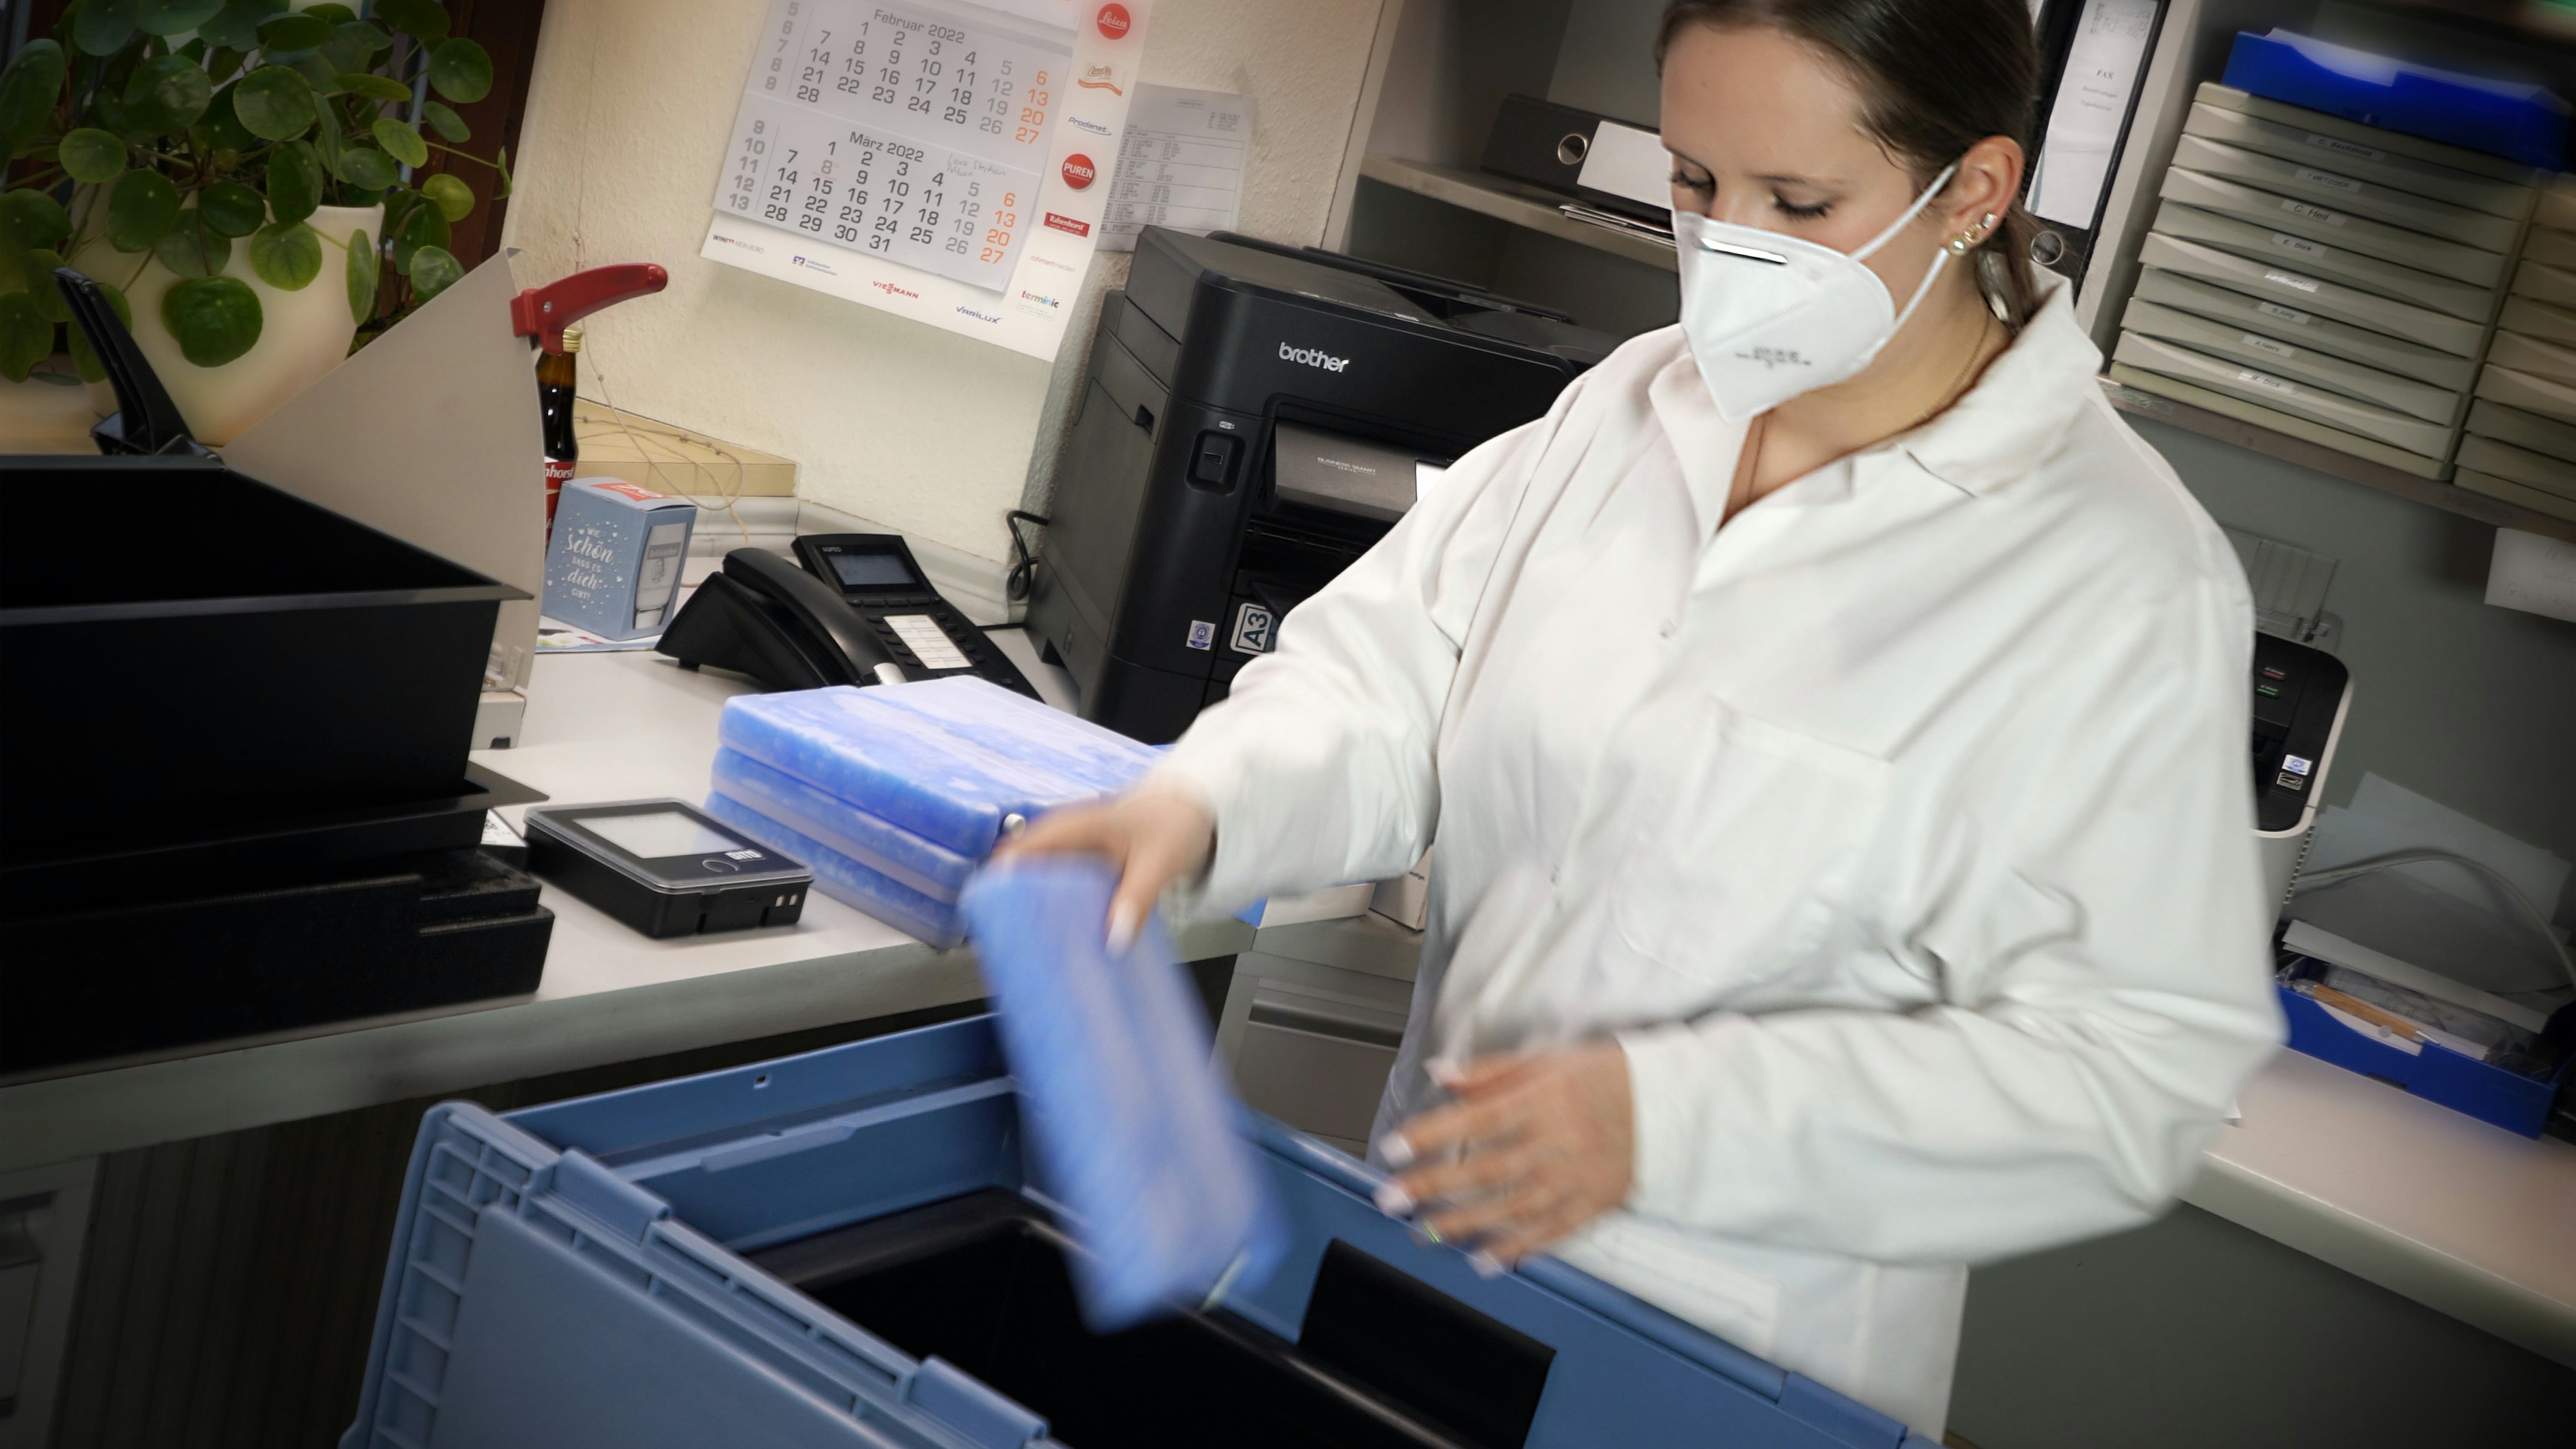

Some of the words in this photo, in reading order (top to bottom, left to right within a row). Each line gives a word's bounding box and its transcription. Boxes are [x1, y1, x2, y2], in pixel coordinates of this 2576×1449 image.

[874, 9, 924, 33] Februar
[928, 24, 965, 44] 2022
[1098, 12, 1127, 29] Leica
[787, 2, 799, 16] 5
[860, 22, 869, 35] 1
[893, 30, 906, 46] 2
[929, 40, 941, 56] 3
[964, 51, 976, 66] 4
[1001, 60, 1013, 75] 5
[1036, 70, 1048, 85] 6
[782, 21, 793, 35] 6
[820, 30, 831, 44] 7
[854, 40, 866, 55] 8
[888, 49, 900, 65] 9
[921, 58, 942, 76] 10
[956, 68, 975, 86] 11
[991, 79, 1013, 96] 12
[1029, 88, 1049, 107] 13
[2096, 70, 2114, 79] FAX
[765, 76, 777, 91] 9
[796, 85, 820, 103] 28
[777, 39, 788, 53] 7
[811, 48, 830, 66] 14
[845, 58, 865, 75] 15
[880, 67, 900, 85] 16
[915, 77, 937, 94] 17
[951, 88, 972, 106] 18
[986, 97, 1008, 115] 19
[1020, 107, 1045, 126] 20
[771, 58, 782, 72] 8
[802, 66, 824, 84] 21
[837, 76, 860, 95] 22
[872, 86, 896, 104] 23
[907, 96, 931, 115] 24
[943, 106, 968, 125] 25
[979, 117, 1003, 134] 26
[1015, 126, 1039, 144] 27
[1068, 117, 1107, 132] Prodanet
[849, 131, 884, 152] März
[886, 142, 924, 163] 2022
[753, 120, 765, 134] 9
[828, 141, 836, 156] 1
[860, 151, 873, 167] 2
[896, 161, 909, 176] 3
[931, 172, 944, 187] 4
[968, 182, 980, 197] 5
[1003, 192, 1016, 208] 6
[1064, 163, 1093, 178] PUREN
[744, 138, 765, 155] 10
[787, 149, 799, 164] 7
[821, 160, 833, 175] 8
[856, 170, 869, 185] 9
[888, 179, 910, 197] 10
[923, 189, 943, 207] 11
[960, 200, 980, 218] 12
[995, 210, 1016, 228] 13
[739, 156, 758, 173] 11
[778, 167, 798, 185] 14
[812, 177, 834, 195] 15
[848, 187, 869, 206] 16
[882, 197, 904, 215] 17
[918, 208, 939, 226] 18
[954, 219, 975, 236] 19
[985, 228, 1011, 247] 20
[728, 193, 750, 211] 13
[764, 204, 788, 222] 28
[799, 214, 823, 232] 29
[834, 224, 858, 243] 30
[869, 234, 891, 253] 31
[734, 174, 755, 192] 12
[769, 185, 792, 204] 21
[804, 195, 828, 214] 22
[839, 205, 863, 224] 23
[874, 216, 898, 235] 24
[909, 226, 934, 245] 25
[945, 237, 969, 255] 26
[979, 247, 1005, 264] 27
[1049, 215, 1084, 231] Rabenhorst
[873, 281, 919, 299] VIESSMANN
[1022, 290, 1059, 308] terminic
[1279, 342, 1349, 373] brother
[1317, 457, 1351, 468] BUSINESS
[1352, 465, 1376, 473] SMART
[586, 527, 601, 538] WIE
[567, 568, 598, 590] dich
[571, 556, 590, 569] DASS
[592, 563, 601, 573] ES
[571, 588, 590, 601] GIBT!
[1243, 612, 1268, 647] A3
